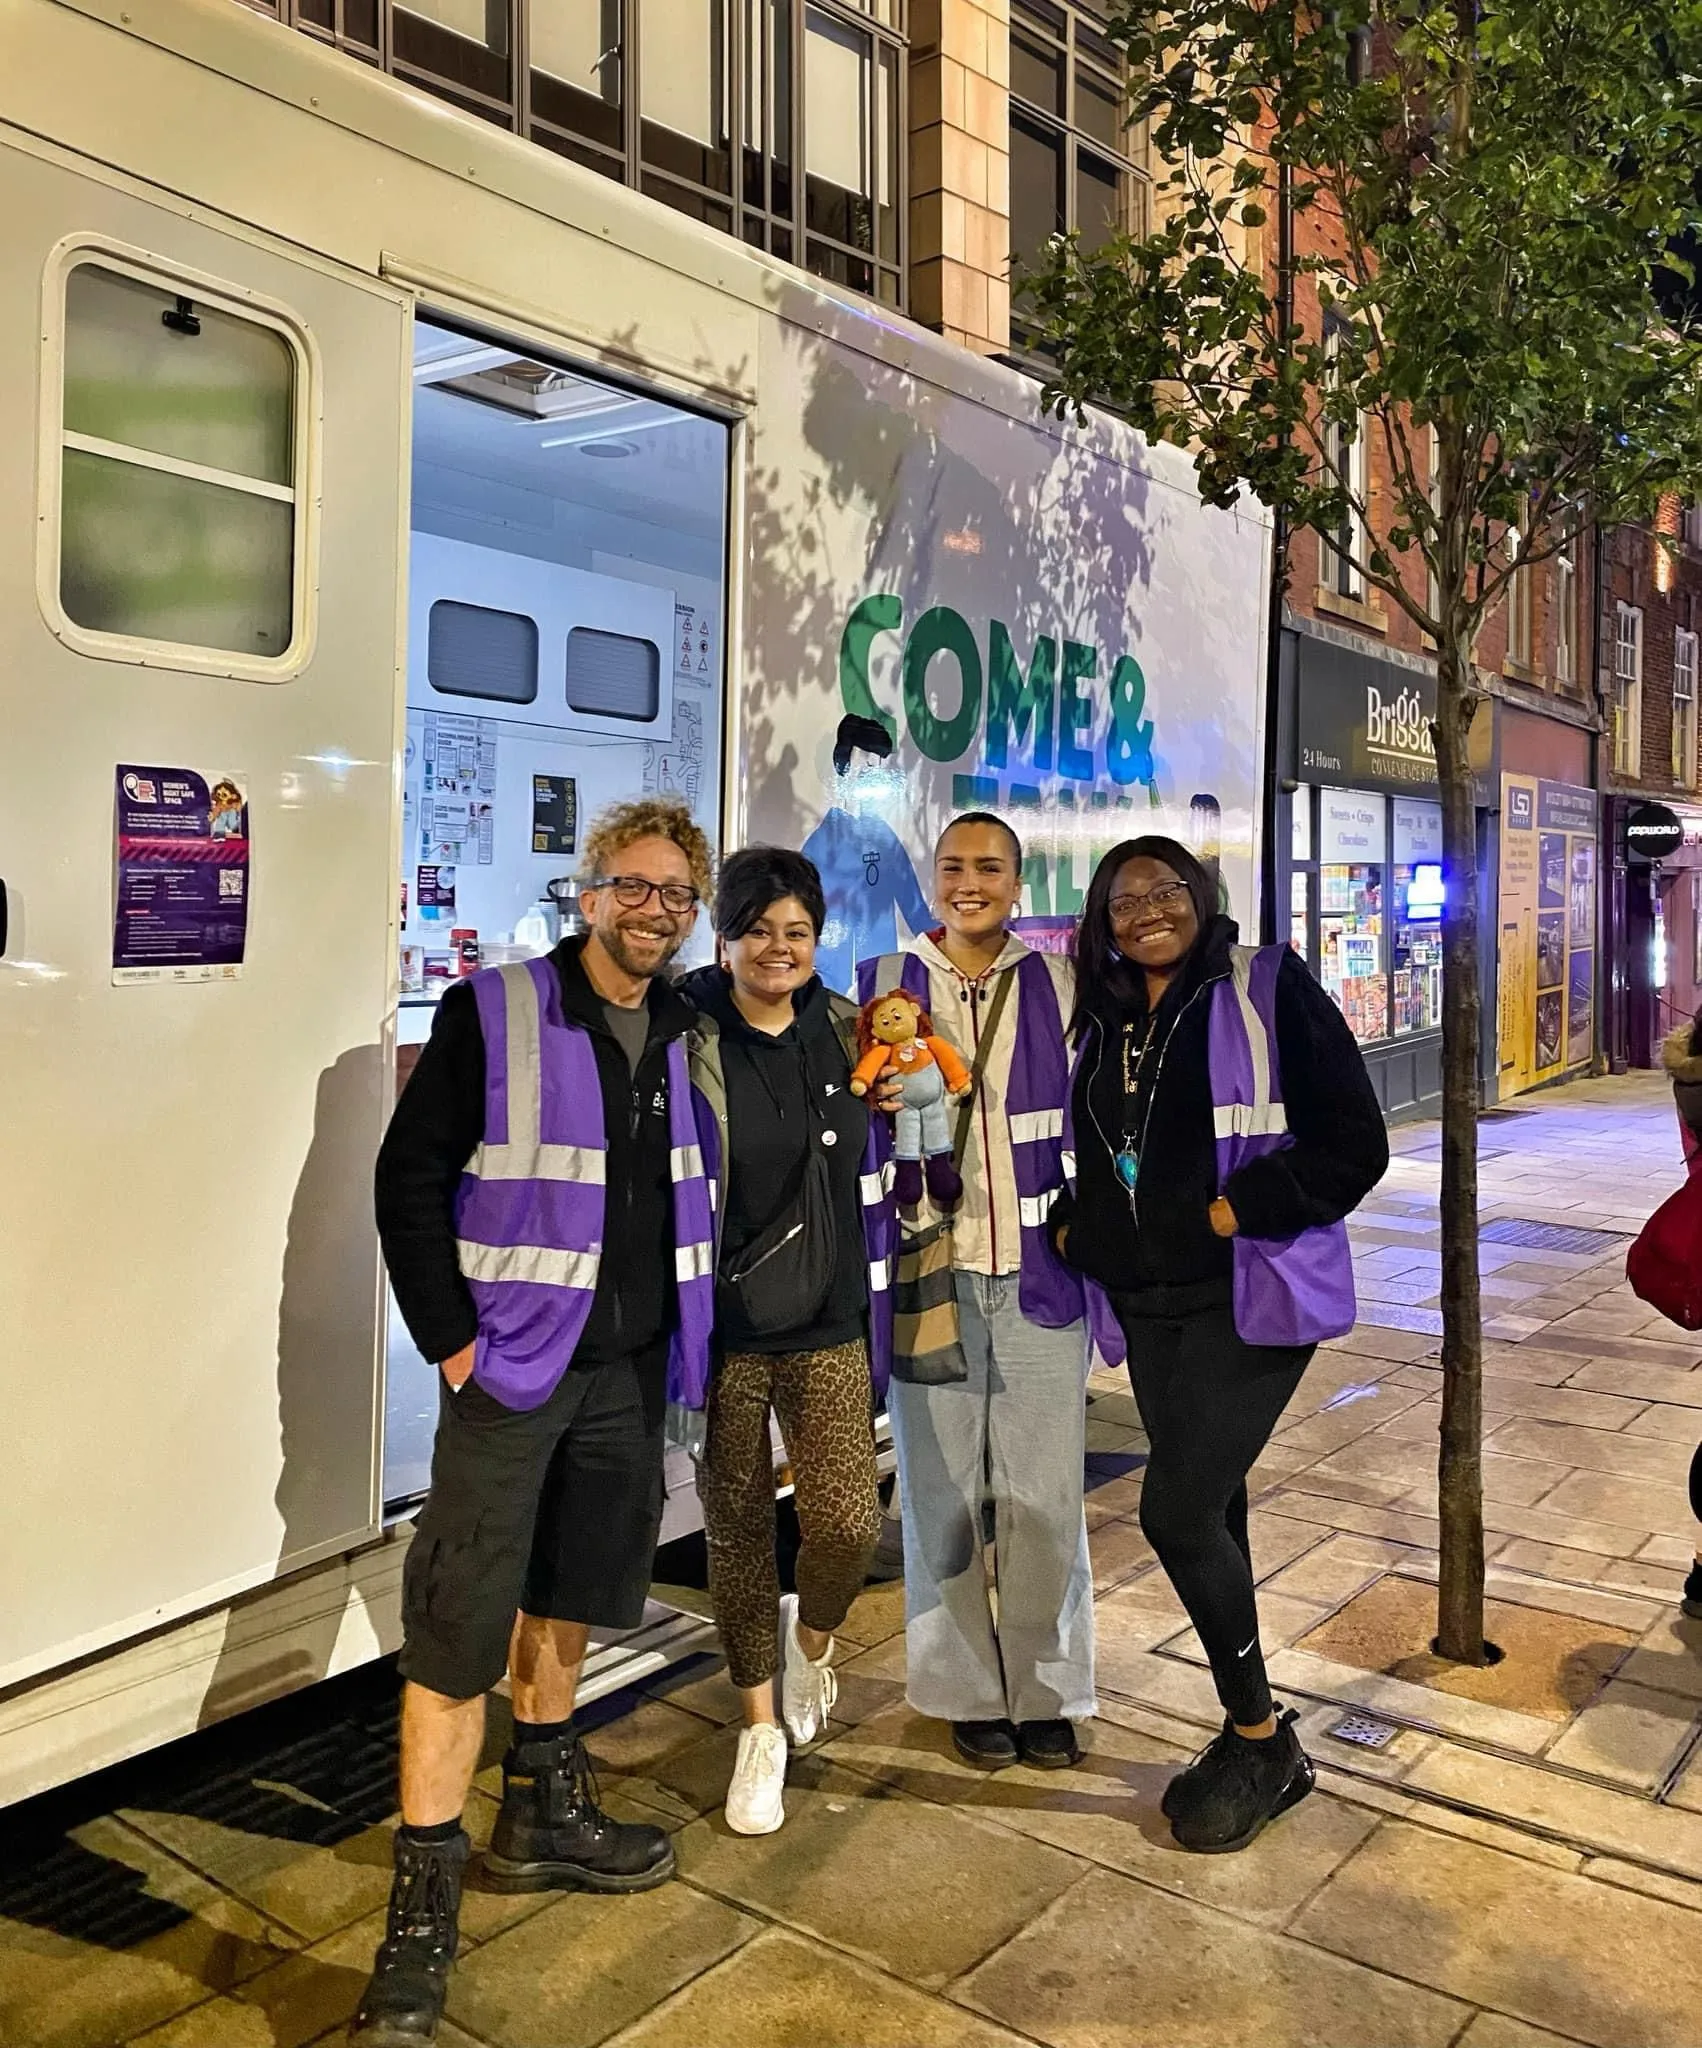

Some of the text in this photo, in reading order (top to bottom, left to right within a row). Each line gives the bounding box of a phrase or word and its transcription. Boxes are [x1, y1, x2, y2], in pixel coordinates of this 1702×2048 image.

[839, 594, 1154, 785] COME &
[1366, 686, 1437, 755] Brigga
[1303, 748, 1341, 770] 24 Hours
